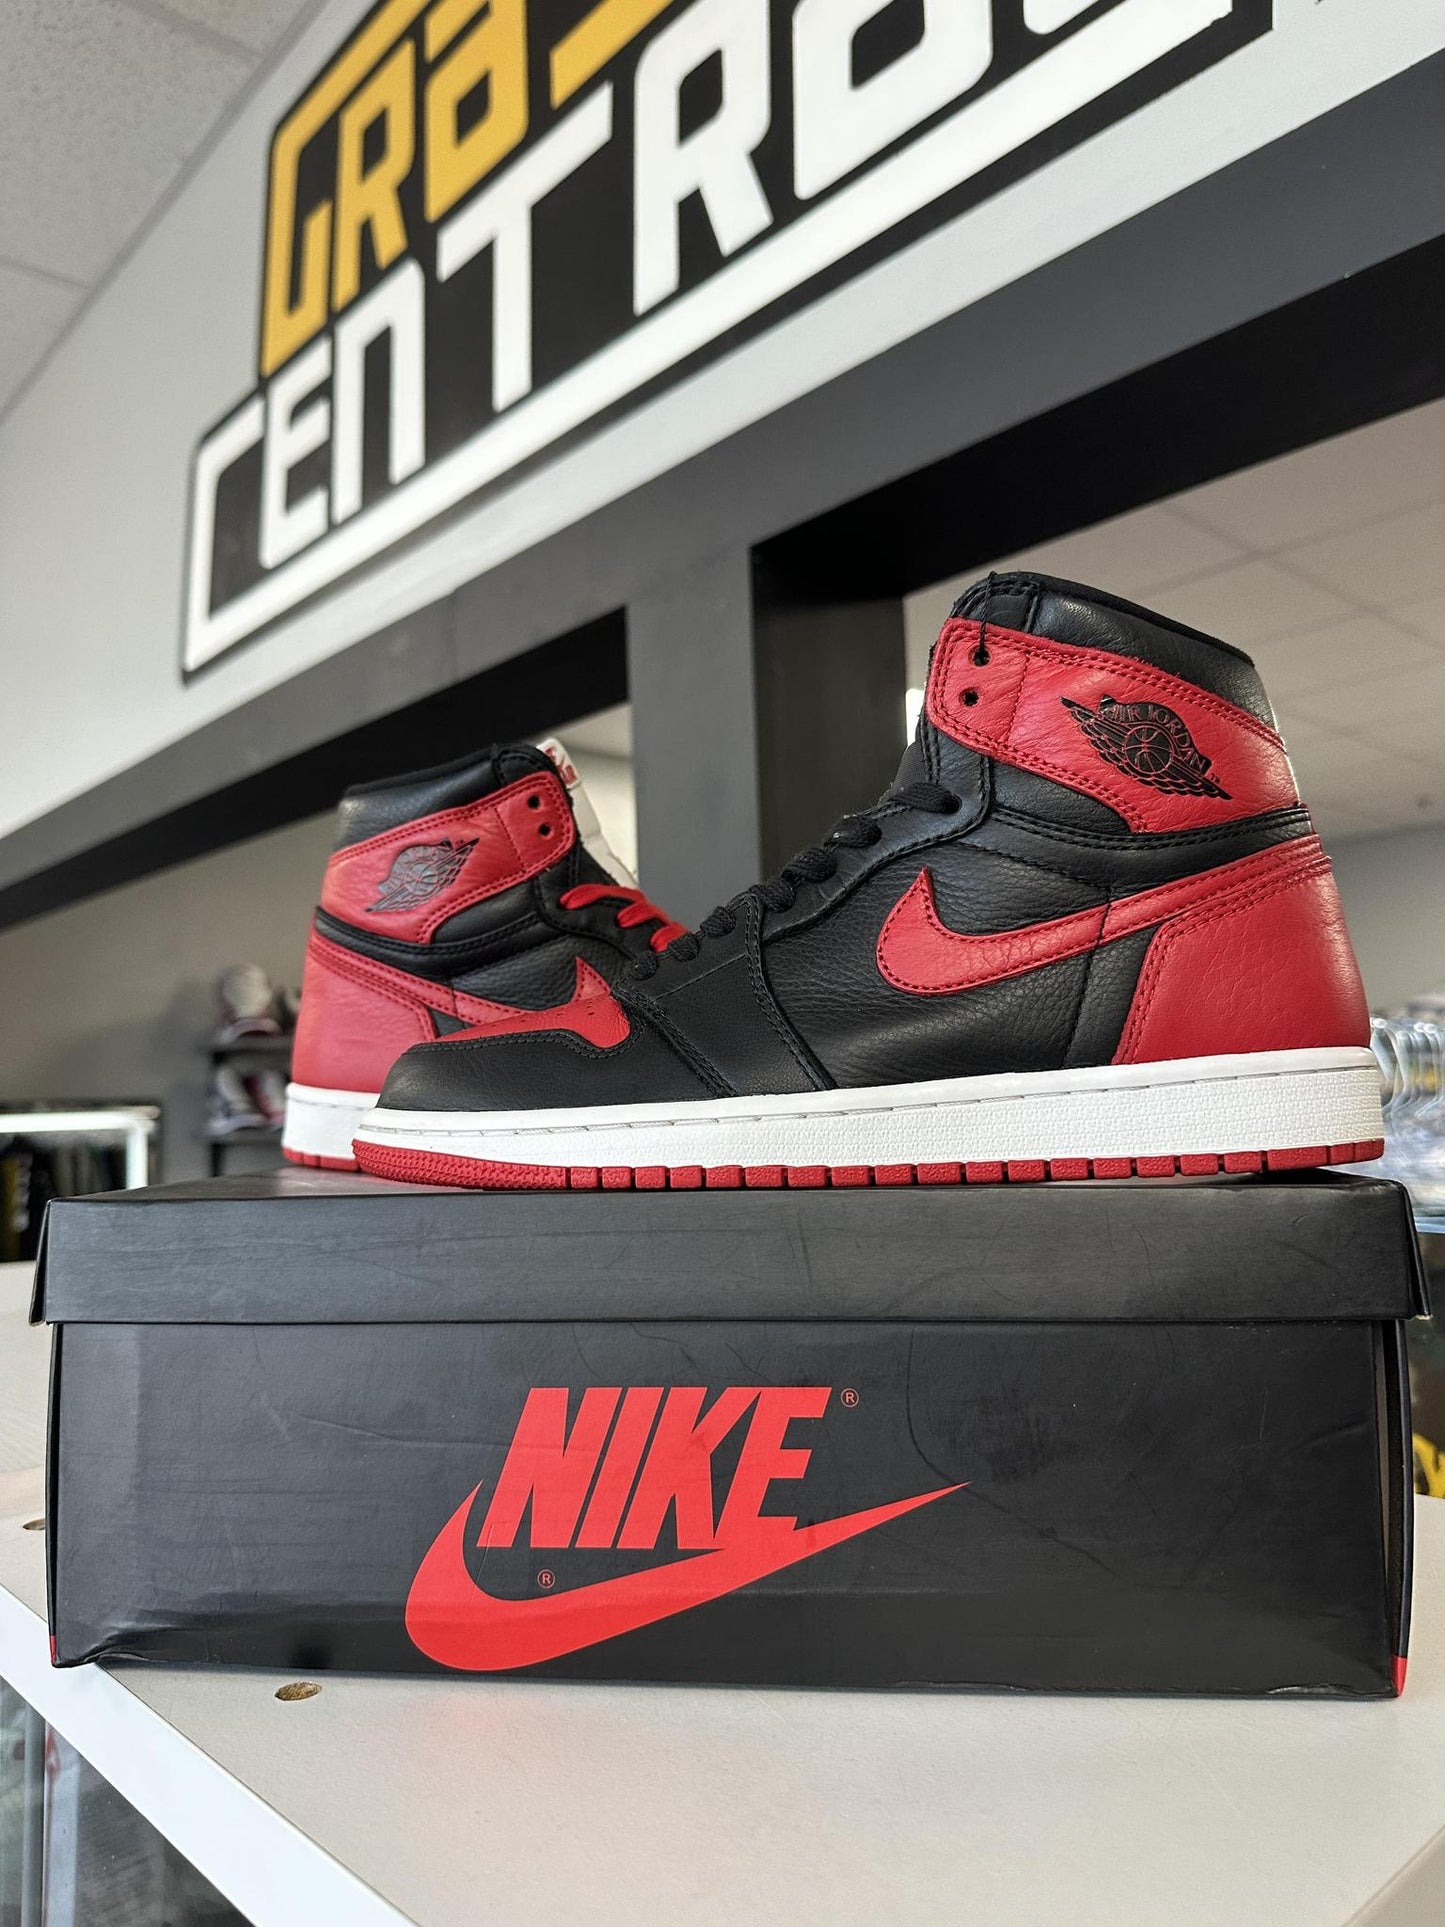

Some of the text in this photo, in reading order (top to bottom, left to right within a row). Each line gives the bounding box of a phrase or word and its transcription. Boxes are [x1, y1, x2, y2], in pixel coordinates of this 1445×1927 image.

[1106, 704, 1206, 772] AIR JORDAN
[477, 1387, 832, 1550] NIKE
